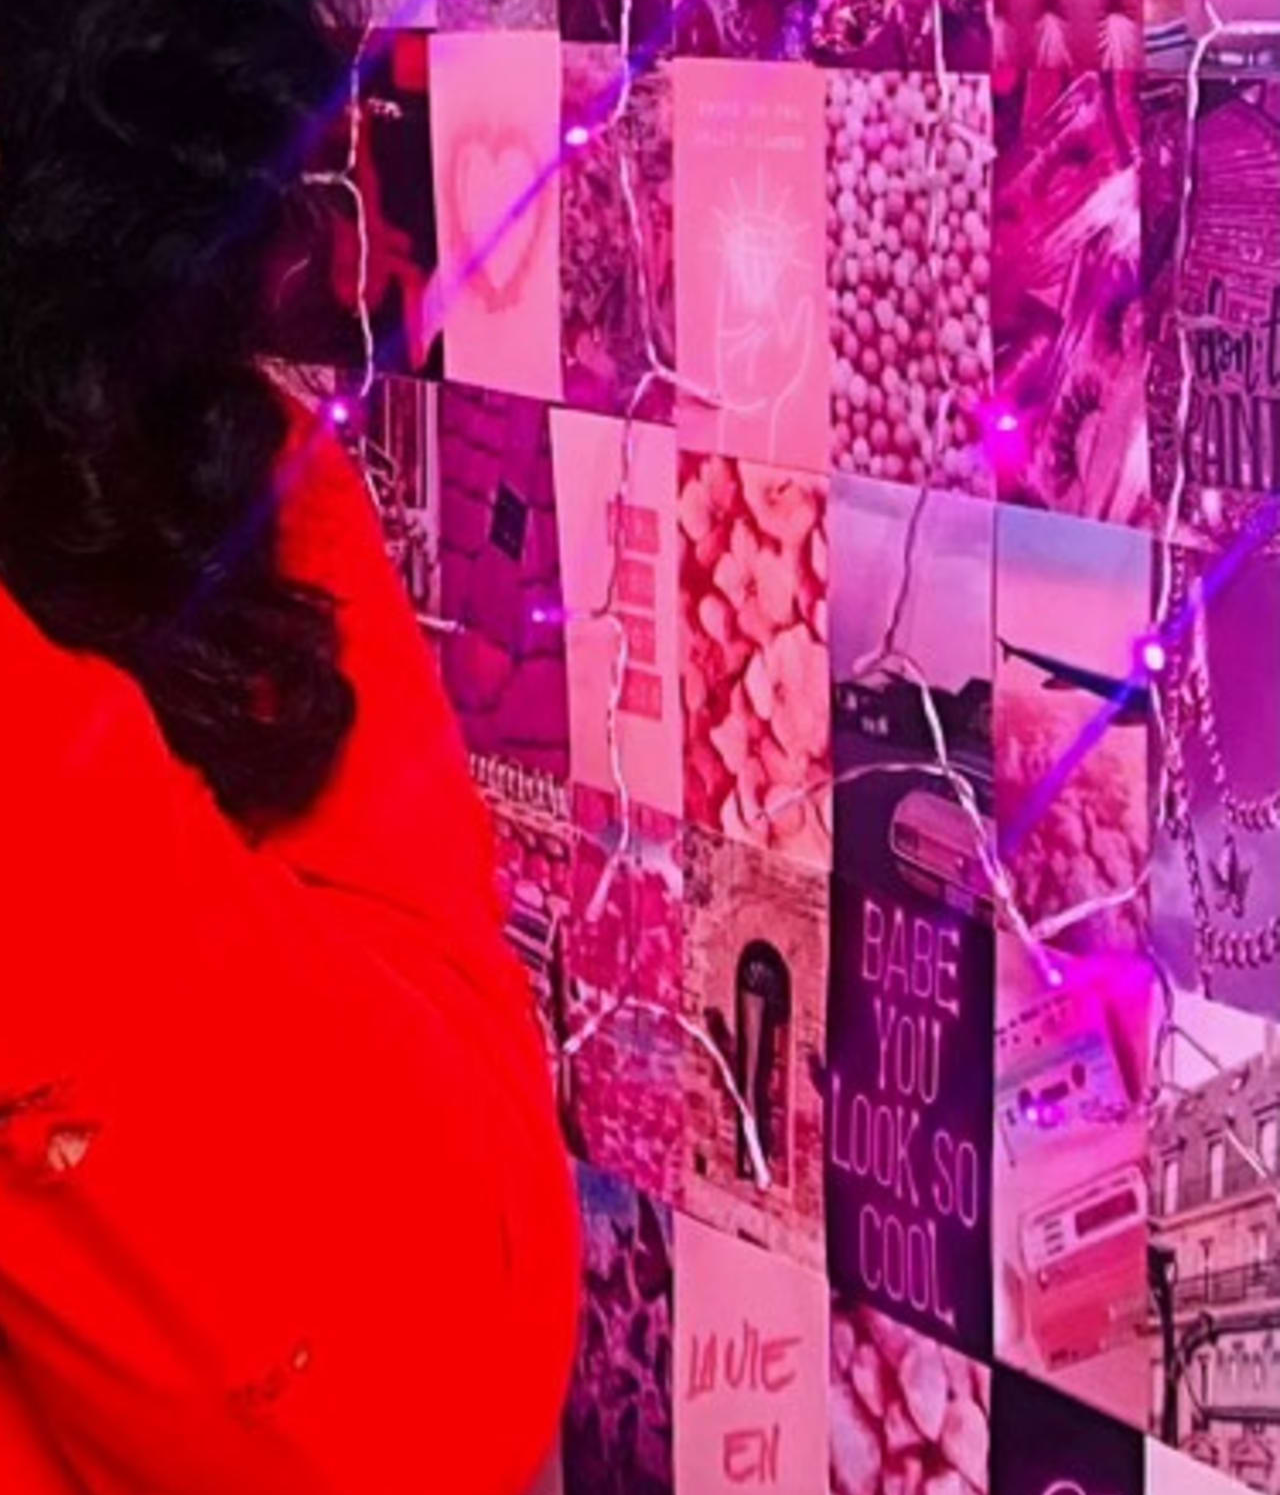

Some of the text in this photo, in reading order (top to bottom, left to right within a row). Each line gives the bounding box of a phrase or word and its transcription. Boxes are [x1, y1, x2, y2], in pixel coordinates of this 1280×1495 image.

[861, 899, 960, 1018] BABE
[873, 996, 942, 1105] YOU
[831, 1072, 979, 1230] LOOK SO
[859, 1202, 957, 1331] COOL
